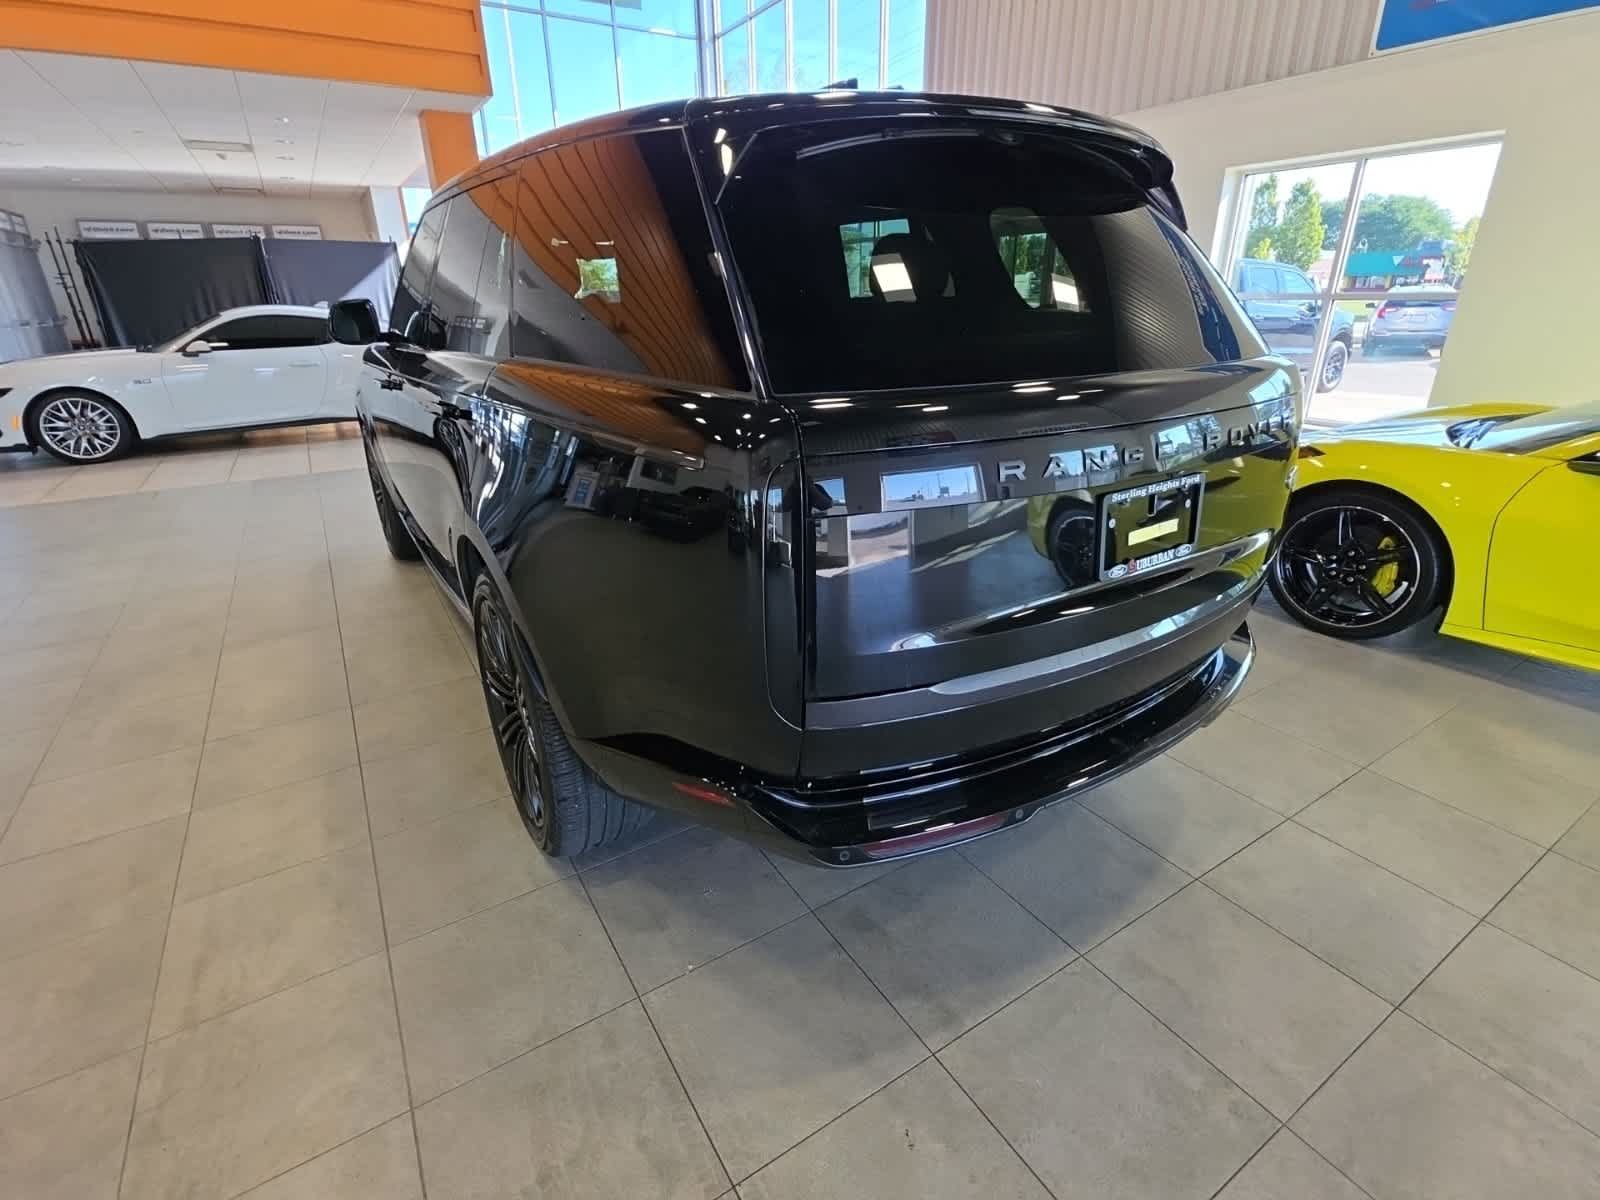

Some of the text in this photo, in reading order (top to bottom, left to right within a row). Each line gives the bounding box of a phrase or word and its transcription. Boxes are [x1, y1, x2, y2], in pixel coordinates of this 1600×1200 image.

[998, 441, 1173, 483] RANGE
[1111, 474, 1201, 503] Sterling Heights Ford
[1127, 548, 1175, 573] SUBURBAN
